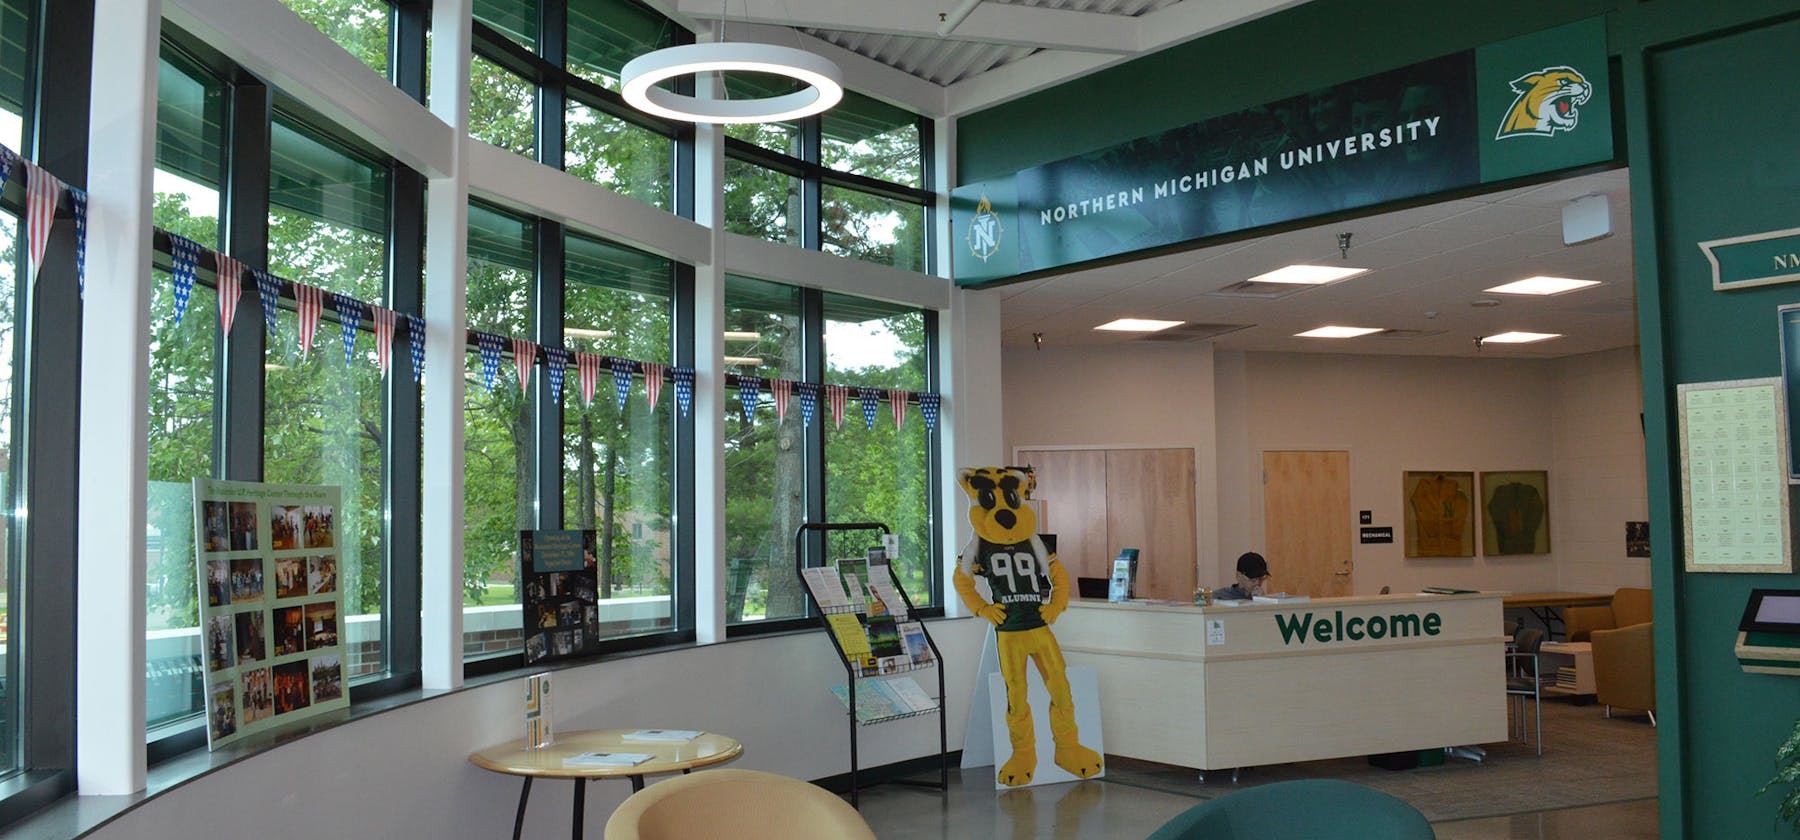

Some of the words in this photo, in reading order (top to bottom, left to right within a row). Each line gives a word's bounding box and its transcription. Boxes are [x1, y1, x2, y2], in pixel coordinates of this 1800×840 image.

[1041, 187, 1143, 225] NORTHERN
[1154, 157, 1267, 199] MICHIGAN
[1280, 116, 1440, 169] UNIVERSITY
[990, 552, 1040, 593] 99
[1001, 594, 1041, 603] ALUMNI
[1274, 610, 1441, 644] Welcome
